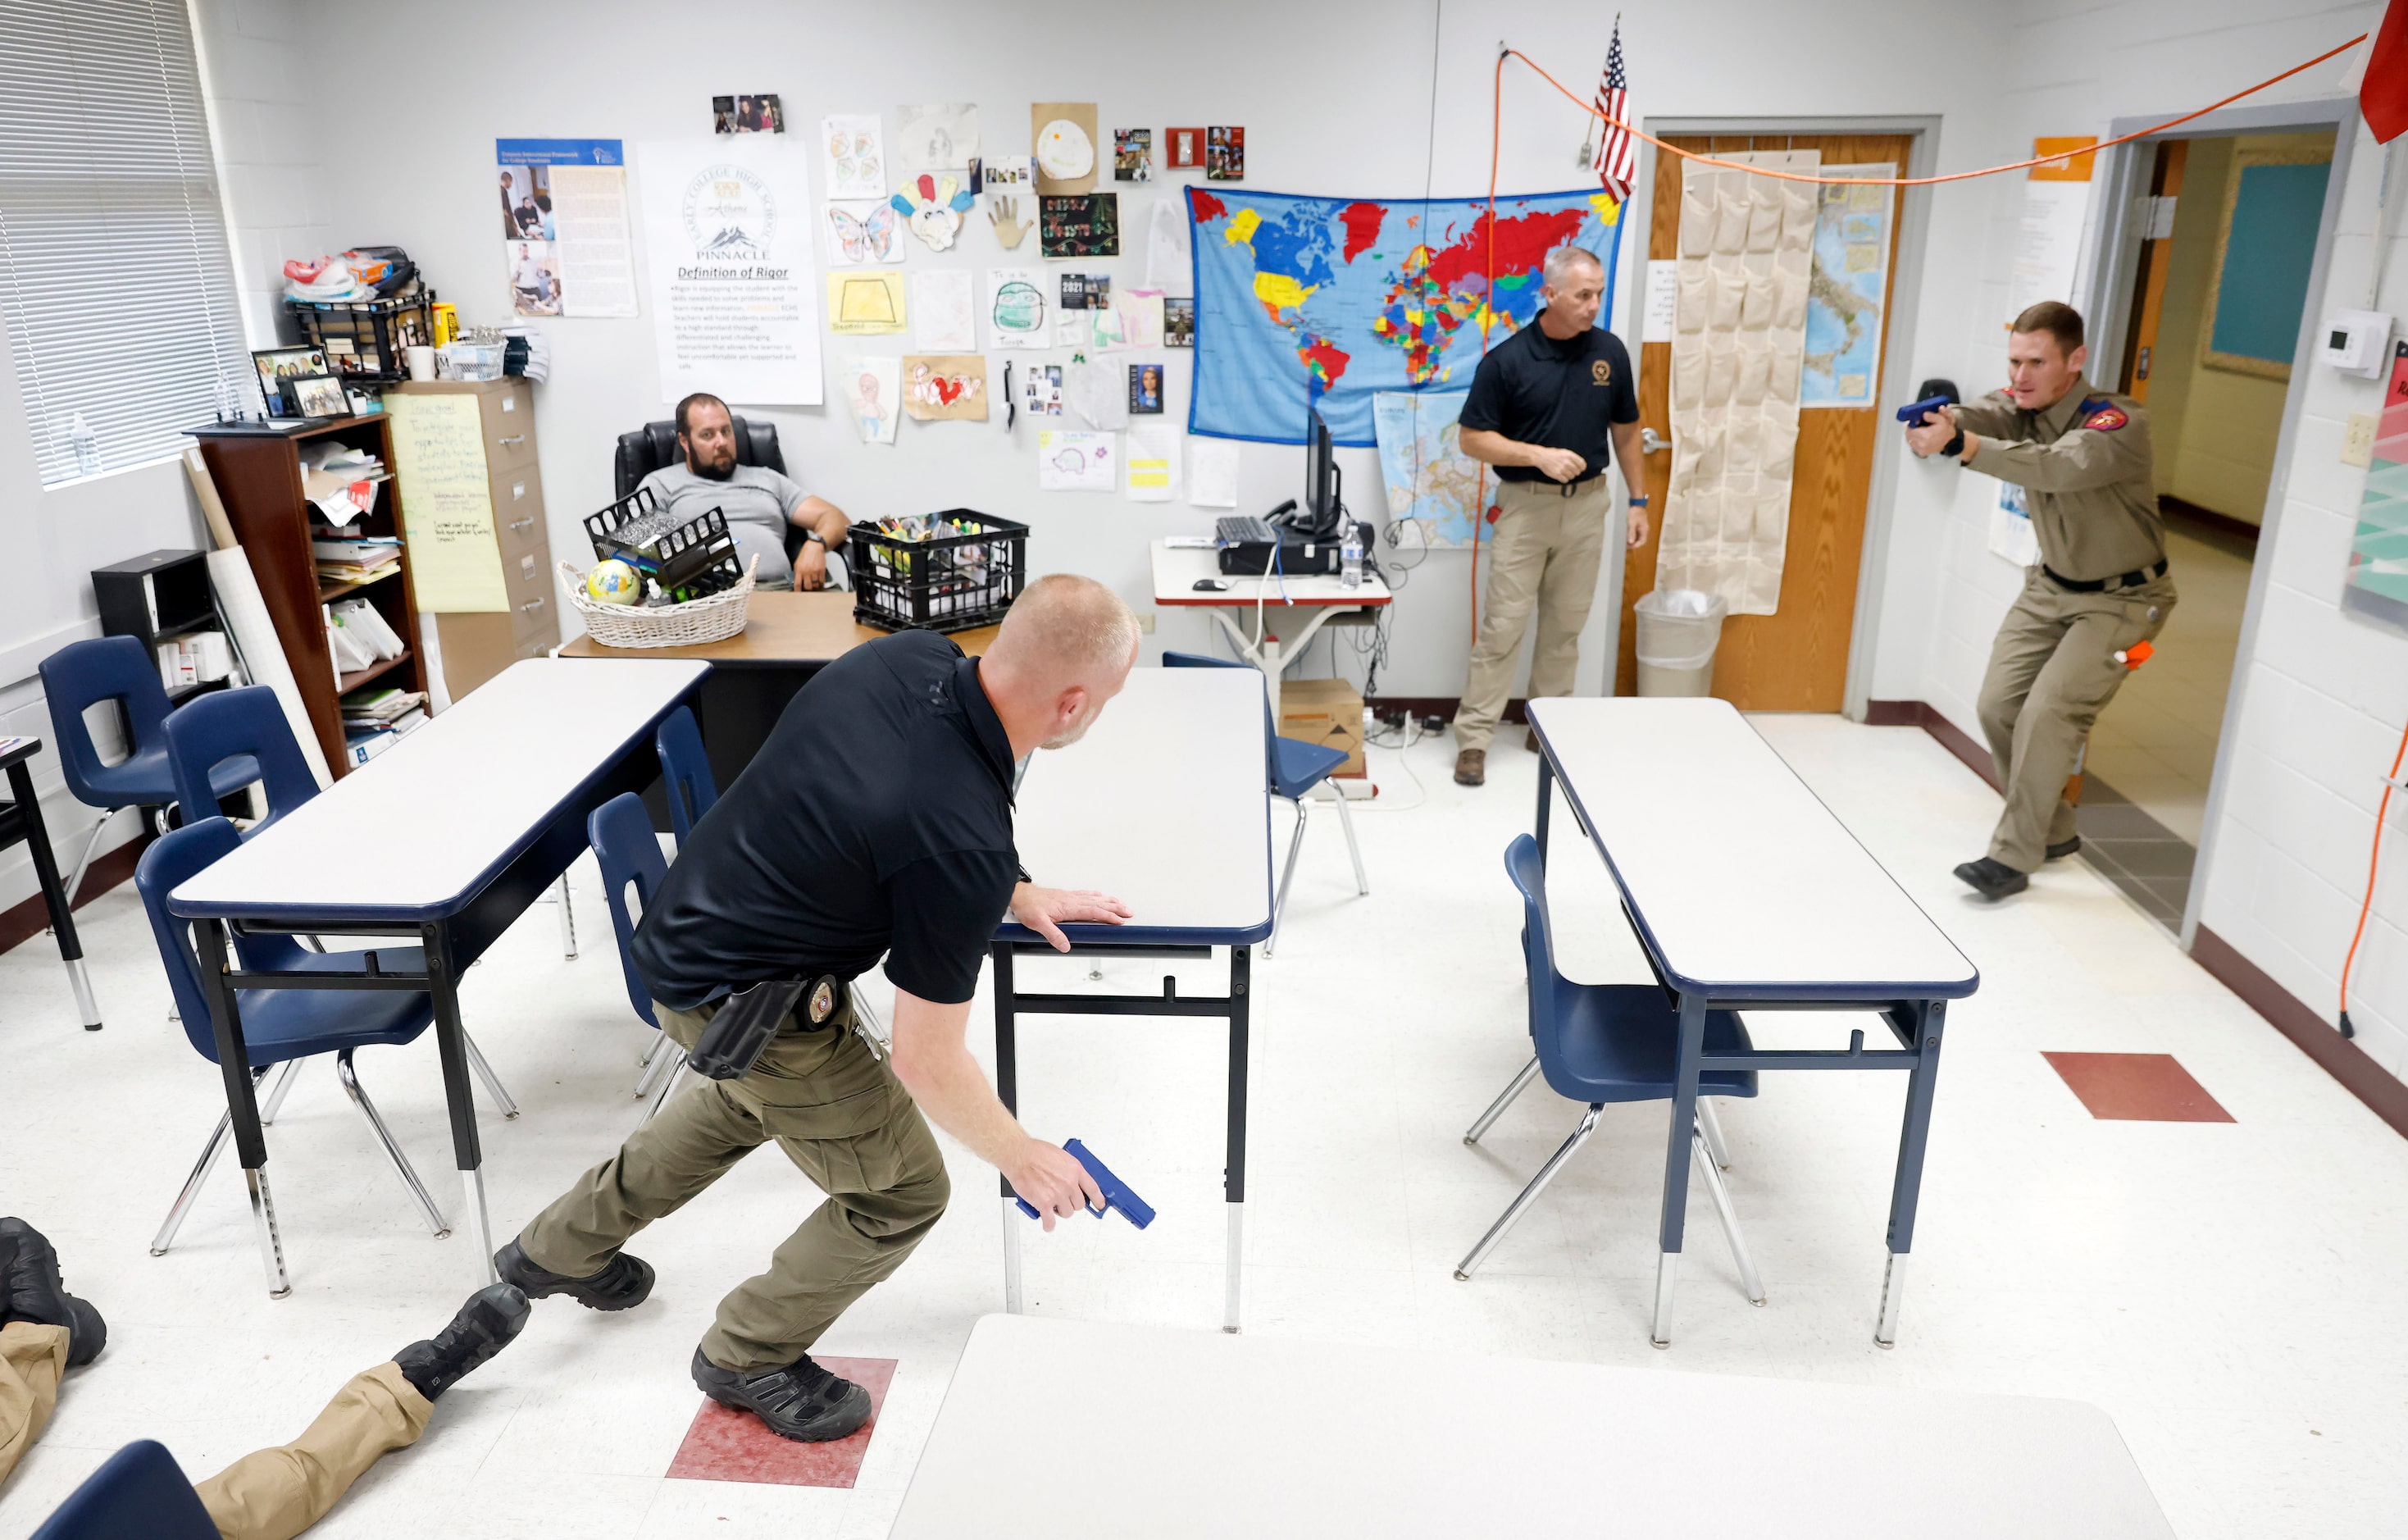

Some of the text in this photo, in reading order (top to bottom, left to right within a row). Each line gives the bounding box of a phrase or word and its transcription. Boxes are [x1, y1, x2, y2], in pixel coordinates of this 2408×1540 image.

[688, 167, 730, 198] COLLEGE
[735, 168, 762, 191] HIGH
[685, 204, 703, 241] EARLY
[762, 193, 776, 239] SCHOOL
[697, 250, 771, 261] PINNACLE
[678, 267, 789, 280] Definition of Rigor
[1062, 282, 1083, 293] 2021
